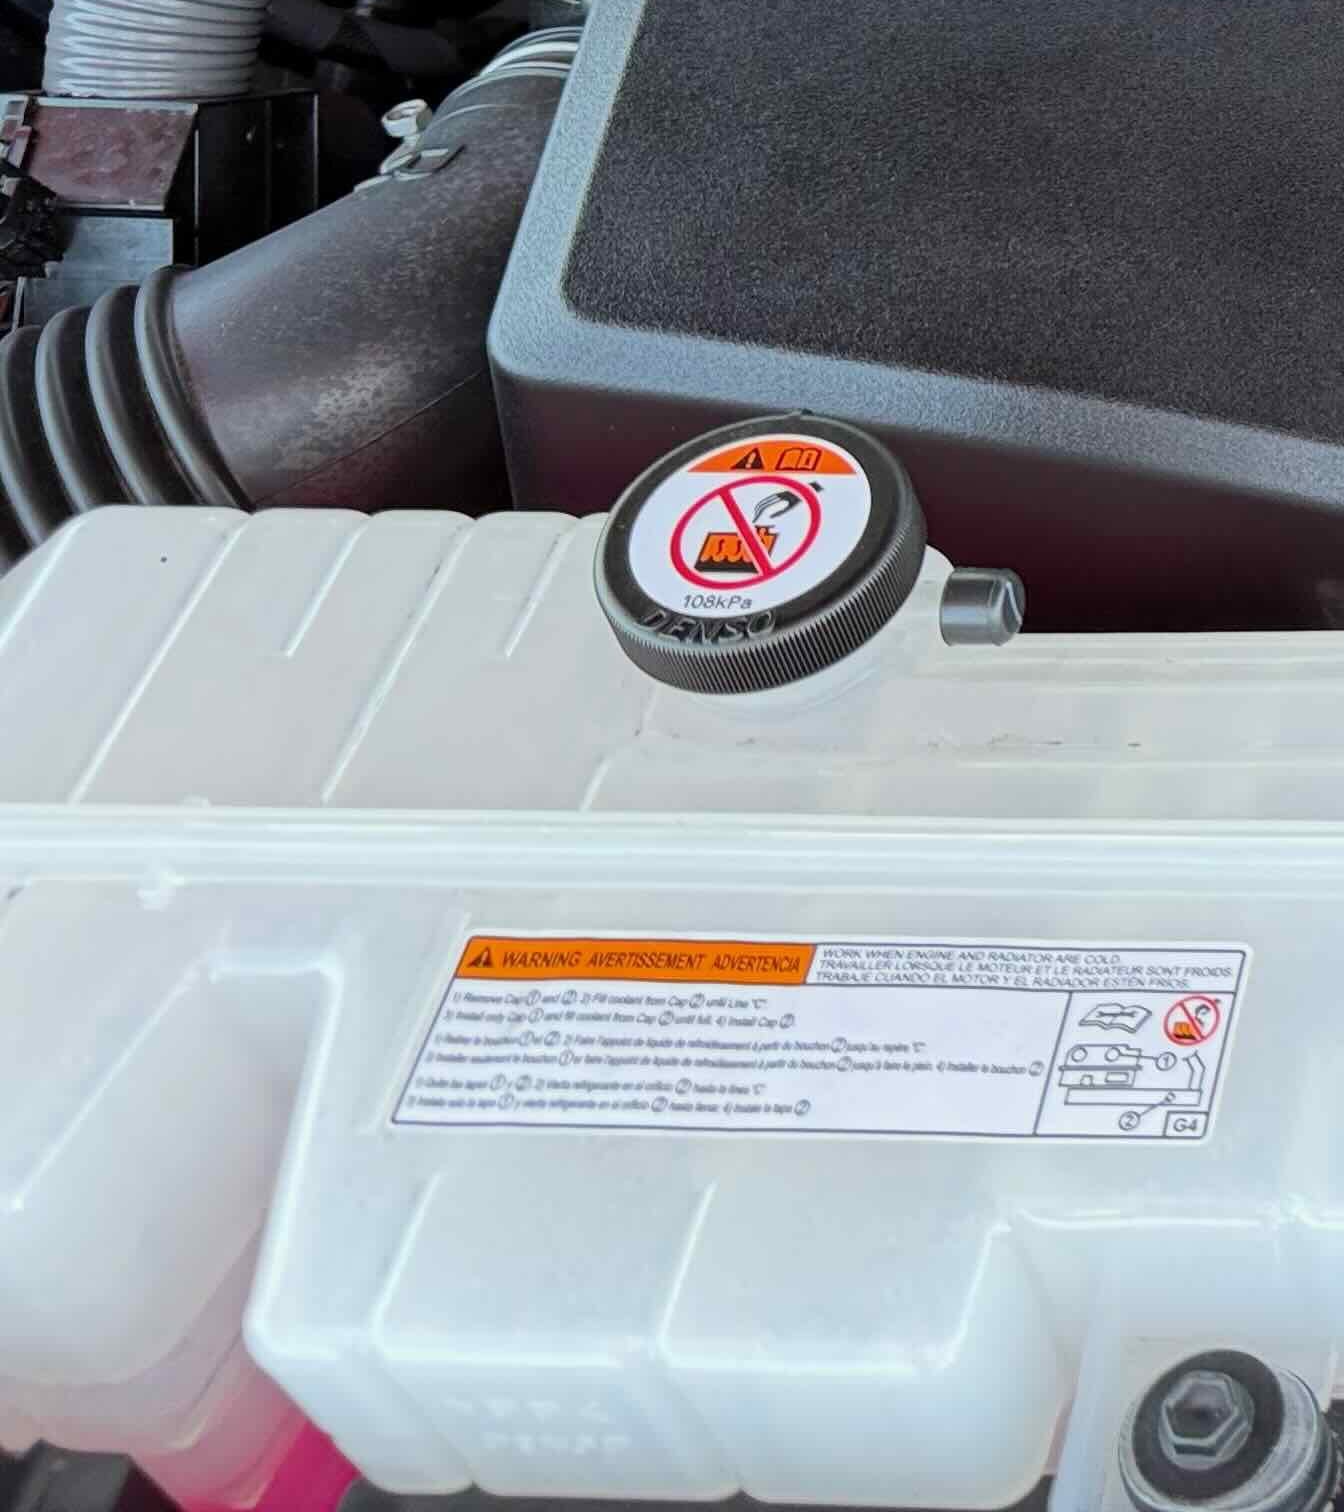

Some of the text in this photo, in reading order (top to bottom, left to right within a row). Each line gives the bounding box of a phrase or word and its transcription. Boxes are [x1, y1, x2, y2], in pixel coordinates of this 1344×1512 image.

[683, 594, 752, 610] 108kPa
[640, 609, 776, 645] DENSO
[502, 951, 801, 974] WARNING AVERTISSEMENT ADVERTENCIA
[823, 949, 862, 960] WORK
[864, 950, 905, 961] WHEN
[907, 950, 954, 962] ENGINE
[957, 951, 985, 963] AND
[988, 951, 1052, 965] RADIATOR
[1055, 953, 1081, 965] ARE
[819, 960, 890, 971] TRAVAILLER
[894, 960, 956, 972] LORSQUE
[959, 962, 975, 972] LE
[977, 962, 1032, 974] MOTEUR
[1035, 963, 1051, 974] ET
[1054, 964, 1069, 975] LE
[1072, 964, 1143, 976] RADIATEUR
[1146, 966, 1181, 977] SONT
[817, 971, 872, 982] TRABAJE
[874, 972, 930, 982] CUANDO
[933, 973, 947, 983] EL
[952, 973, 1000, 985] MOTOR
[1014, 975, 1028, 985] EL
[1031, 976, 1100, 987] RADIADOR
[463, 991, 503, 1004] Remove
[504, 993, 525, 1006] Cap
[541, 992, 560, 1003] and
[608, 994, 642, 1005] coolant
[645, 995, 667, 1006] from
[668, 996, 688, 1008] Cap
[706, 997, 727, 1008] until
[507, 1012, 527, 1024] Cap
[544, 1011, 563, 1022] and
[576, 1012, 611, 1023] coolant
[612, 1012, 635, 1023] from
[636, 1014, 657, 1026] Cap
[728, 1015, 756, 1027] Install
[757, 1017, 778, 1029] Cap
[1173, 1118, 1198, 1133] G4
